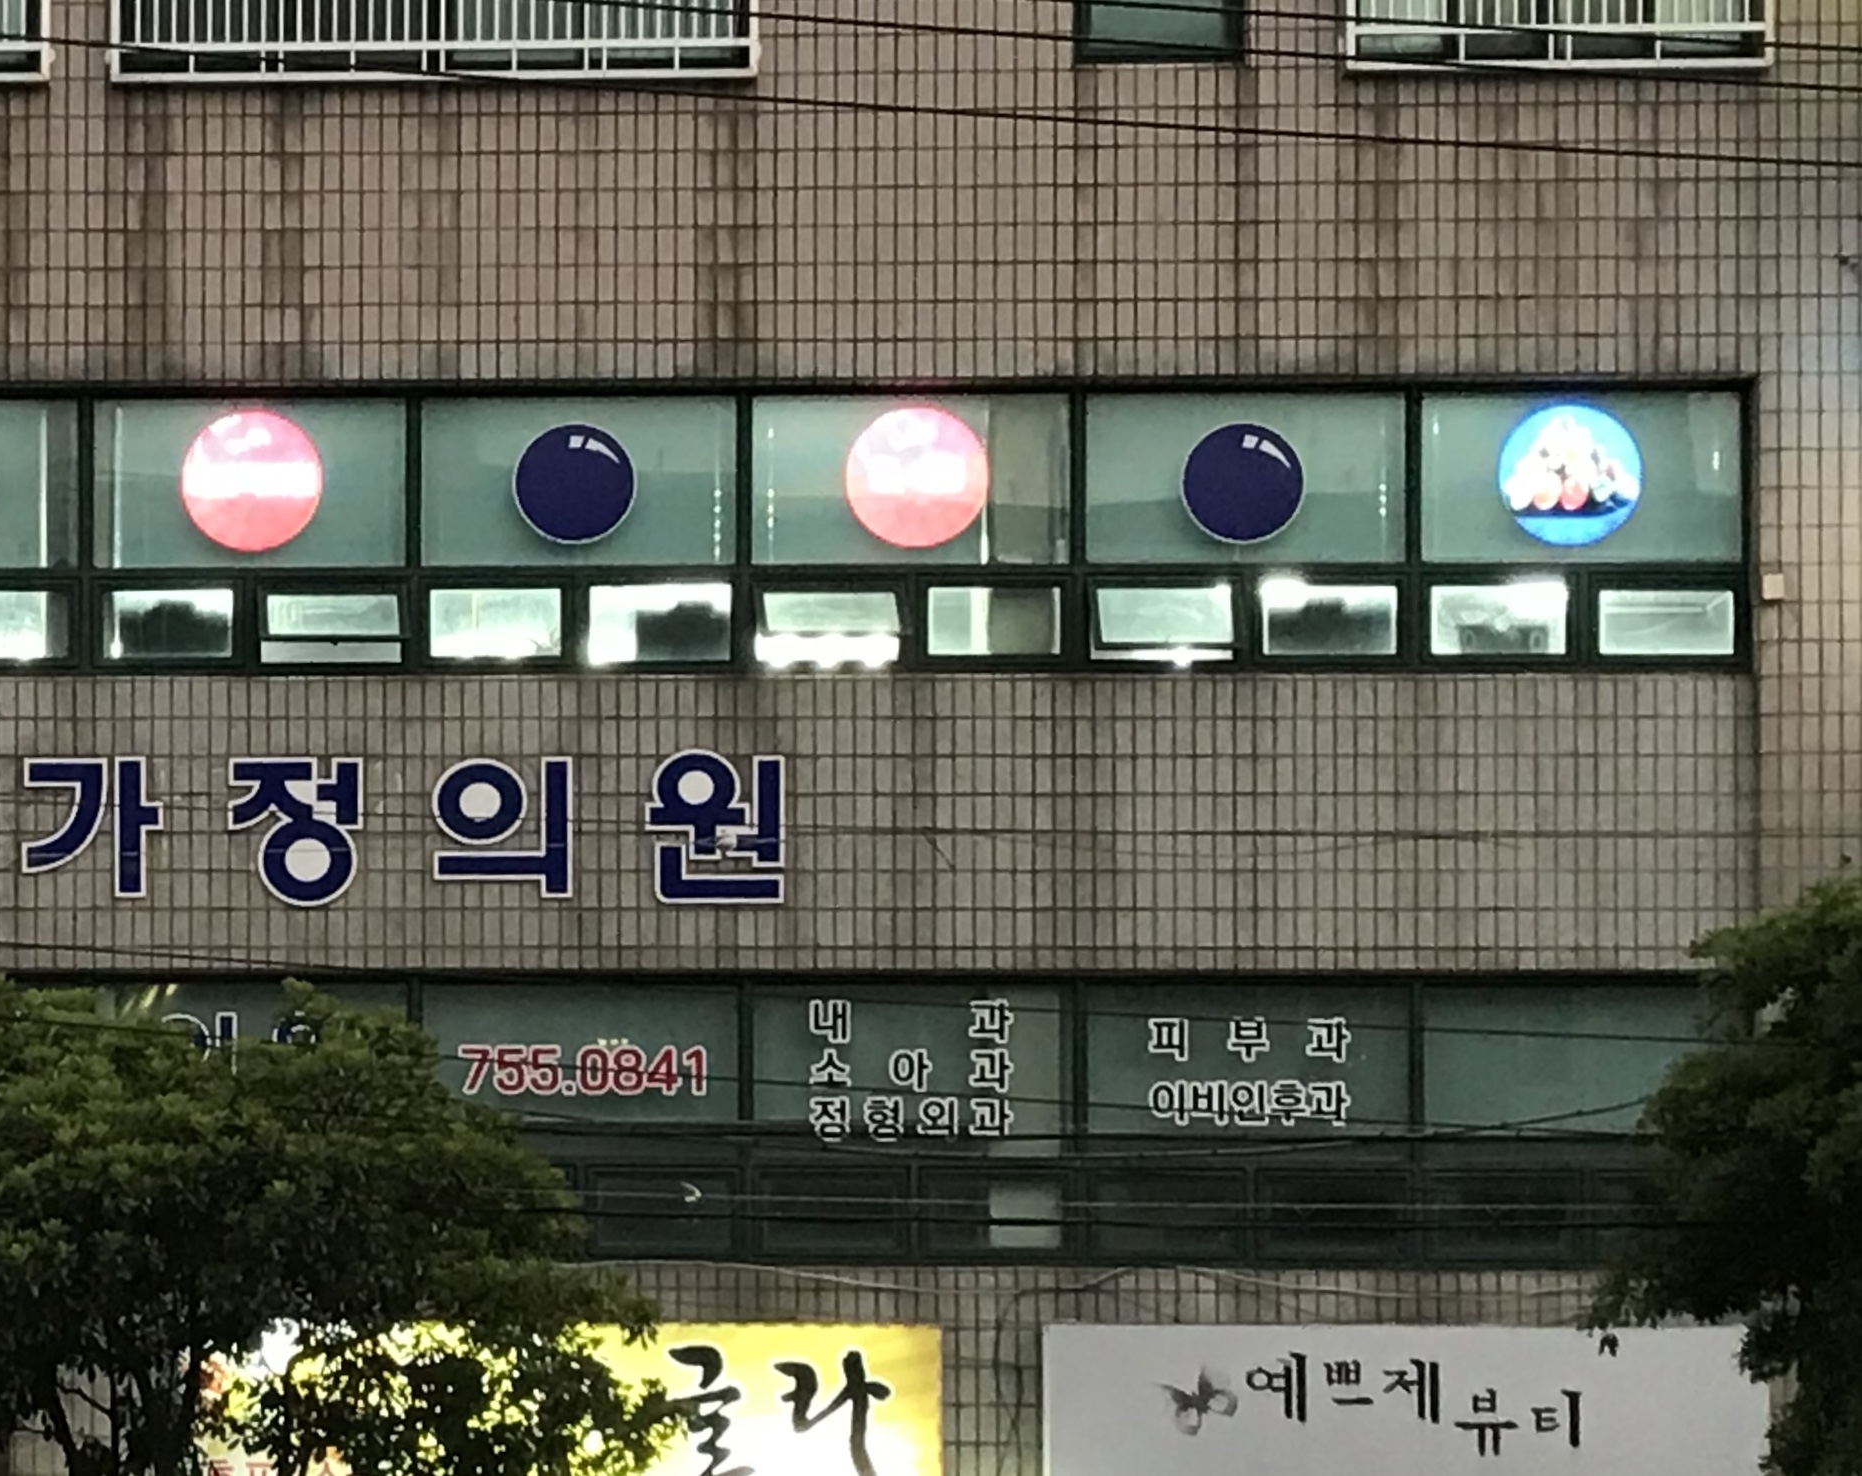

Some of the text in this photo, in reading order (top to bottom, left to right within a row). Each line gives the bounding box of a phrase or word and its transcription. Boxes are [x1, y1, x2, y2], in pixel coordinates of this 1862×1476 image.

[458, 1045, 707, 1096] 755.0841
[809, 1096, 1014, 1143] 정형외과
[1148, 1080, 1351, 1127] 이비인후과
[1245, 1350, 1583, 1457] 예쁘제 뷰티
